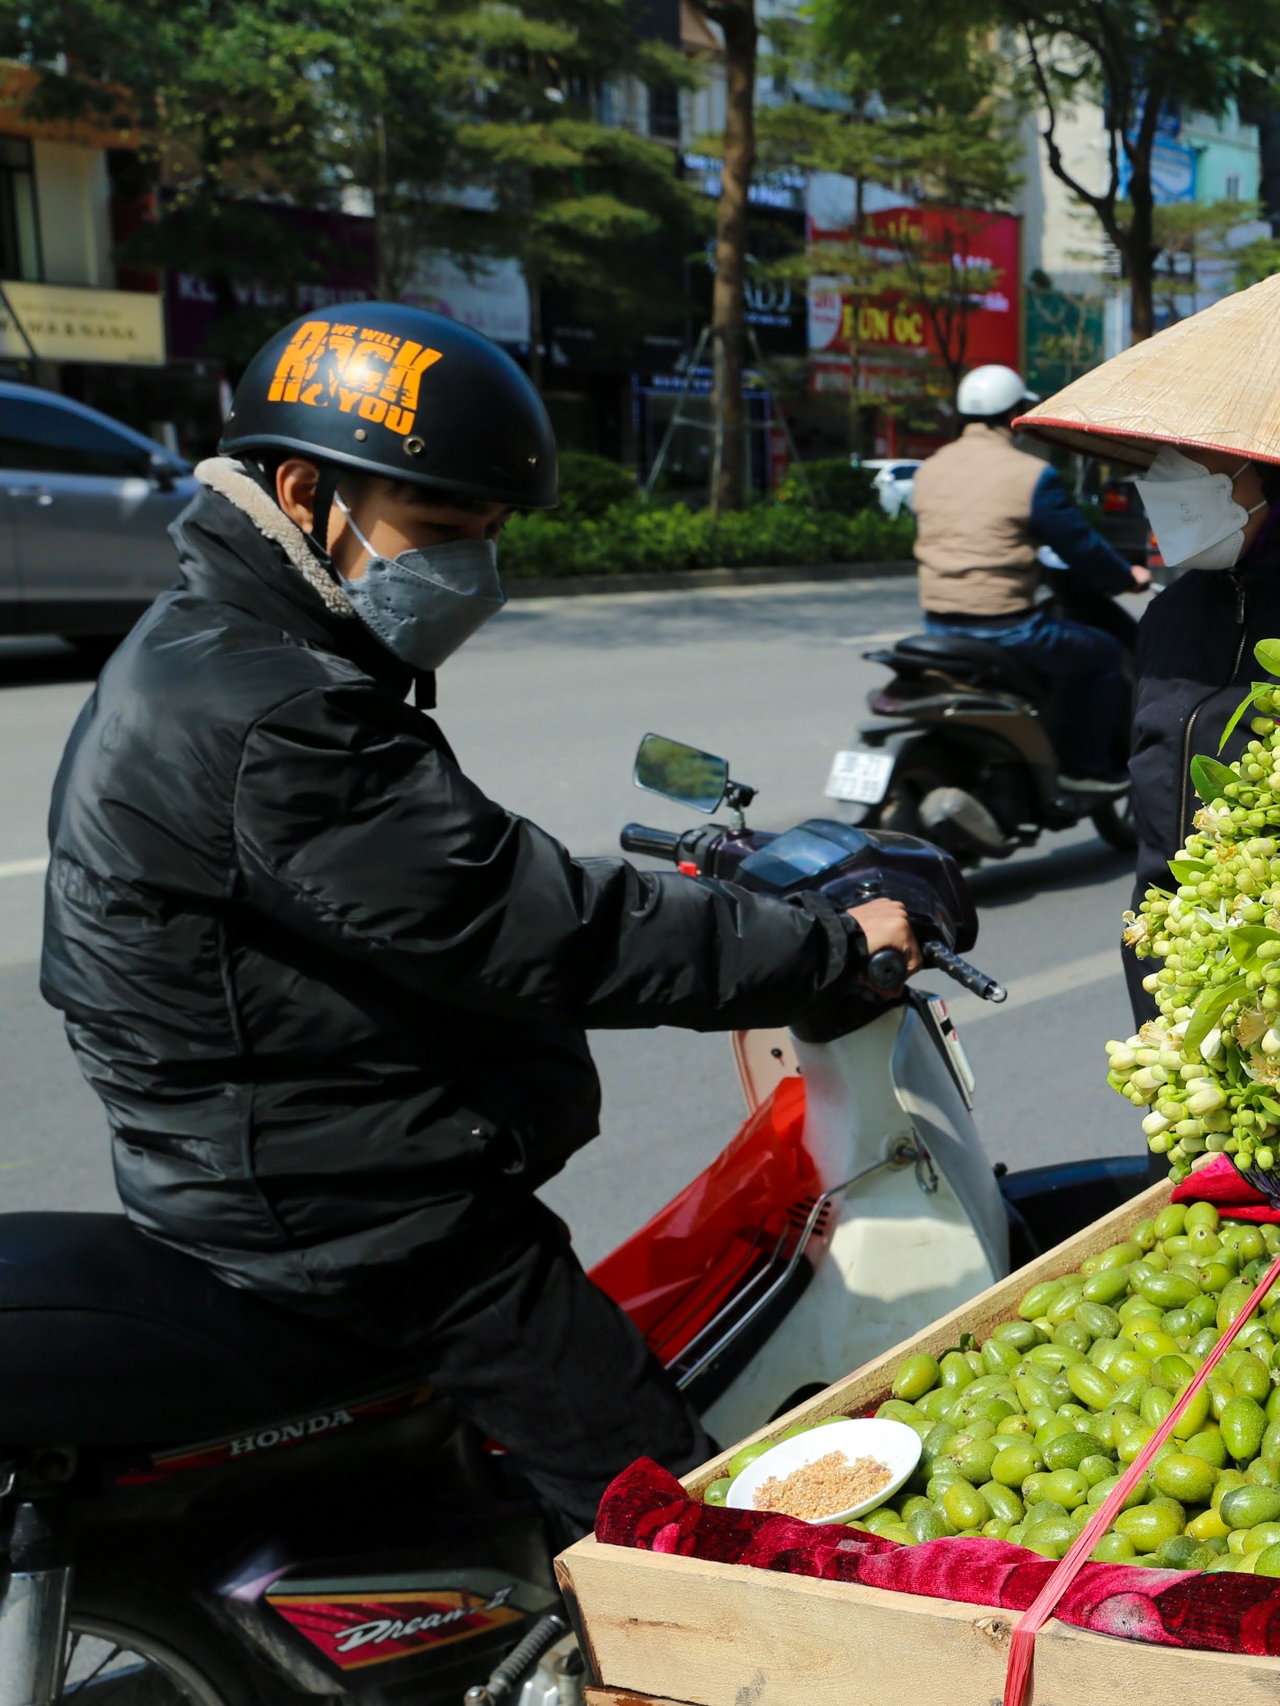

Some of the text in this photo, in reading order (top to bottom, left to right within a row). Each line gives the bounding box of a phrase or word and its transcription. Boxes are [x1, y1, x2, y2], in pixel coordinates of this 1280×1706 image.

[331, 323, 401, 348] WE WILL
[338, 387, 415, 435] YOU
[230, 1409, 354, 1456] HONDA
[334, 1606, 474, 1652] Dream
